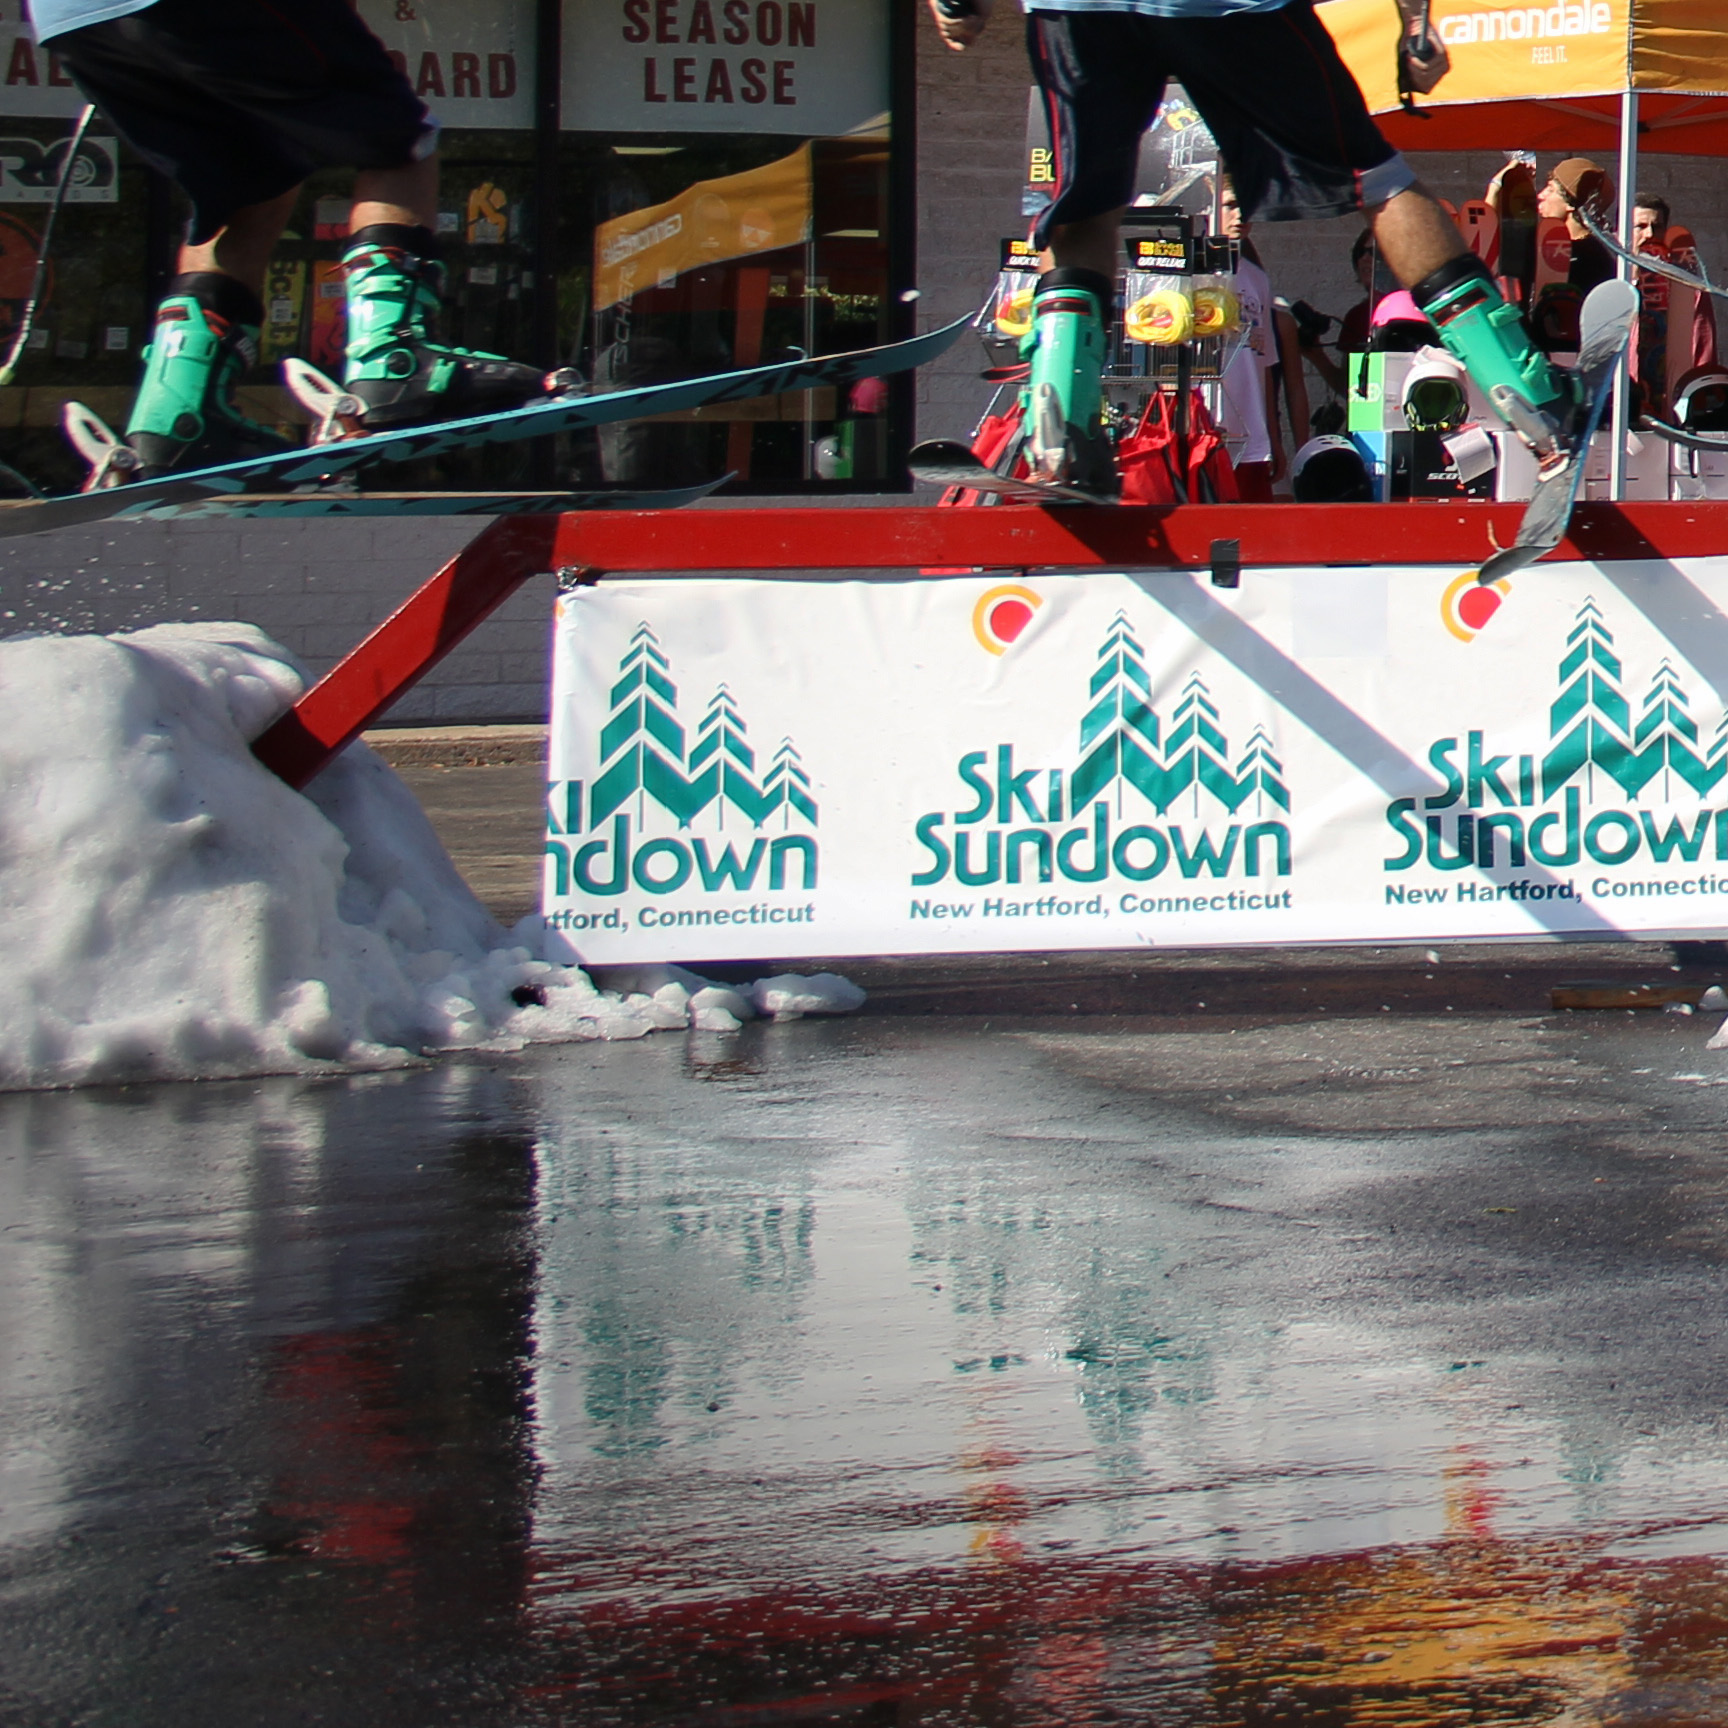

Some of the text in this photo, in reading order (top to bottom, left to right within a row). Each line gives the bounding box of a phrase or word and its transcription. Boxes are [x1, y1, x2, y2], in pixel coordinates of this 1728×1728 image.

[394, 0, 417, 22] &
[1531, 46, 1555, 65] FEEL
[643, 56, 797, 106] LEASE
[1427, 472, 1460, 481] SCO
[954, 743, 1063, 826] Ski
[1423, 729, 1535, 811] Ski
[545, 813, 818, 898] ndown
[911, 801, 1293, 888] Sundown
[910, 888, 1293, 922] New Hartford, Connecticut
[1385, 884, 1448, 904] New
[1456, 879, 1583, 905] Hartford,
[639, 901, 814, 928] Connecticut
